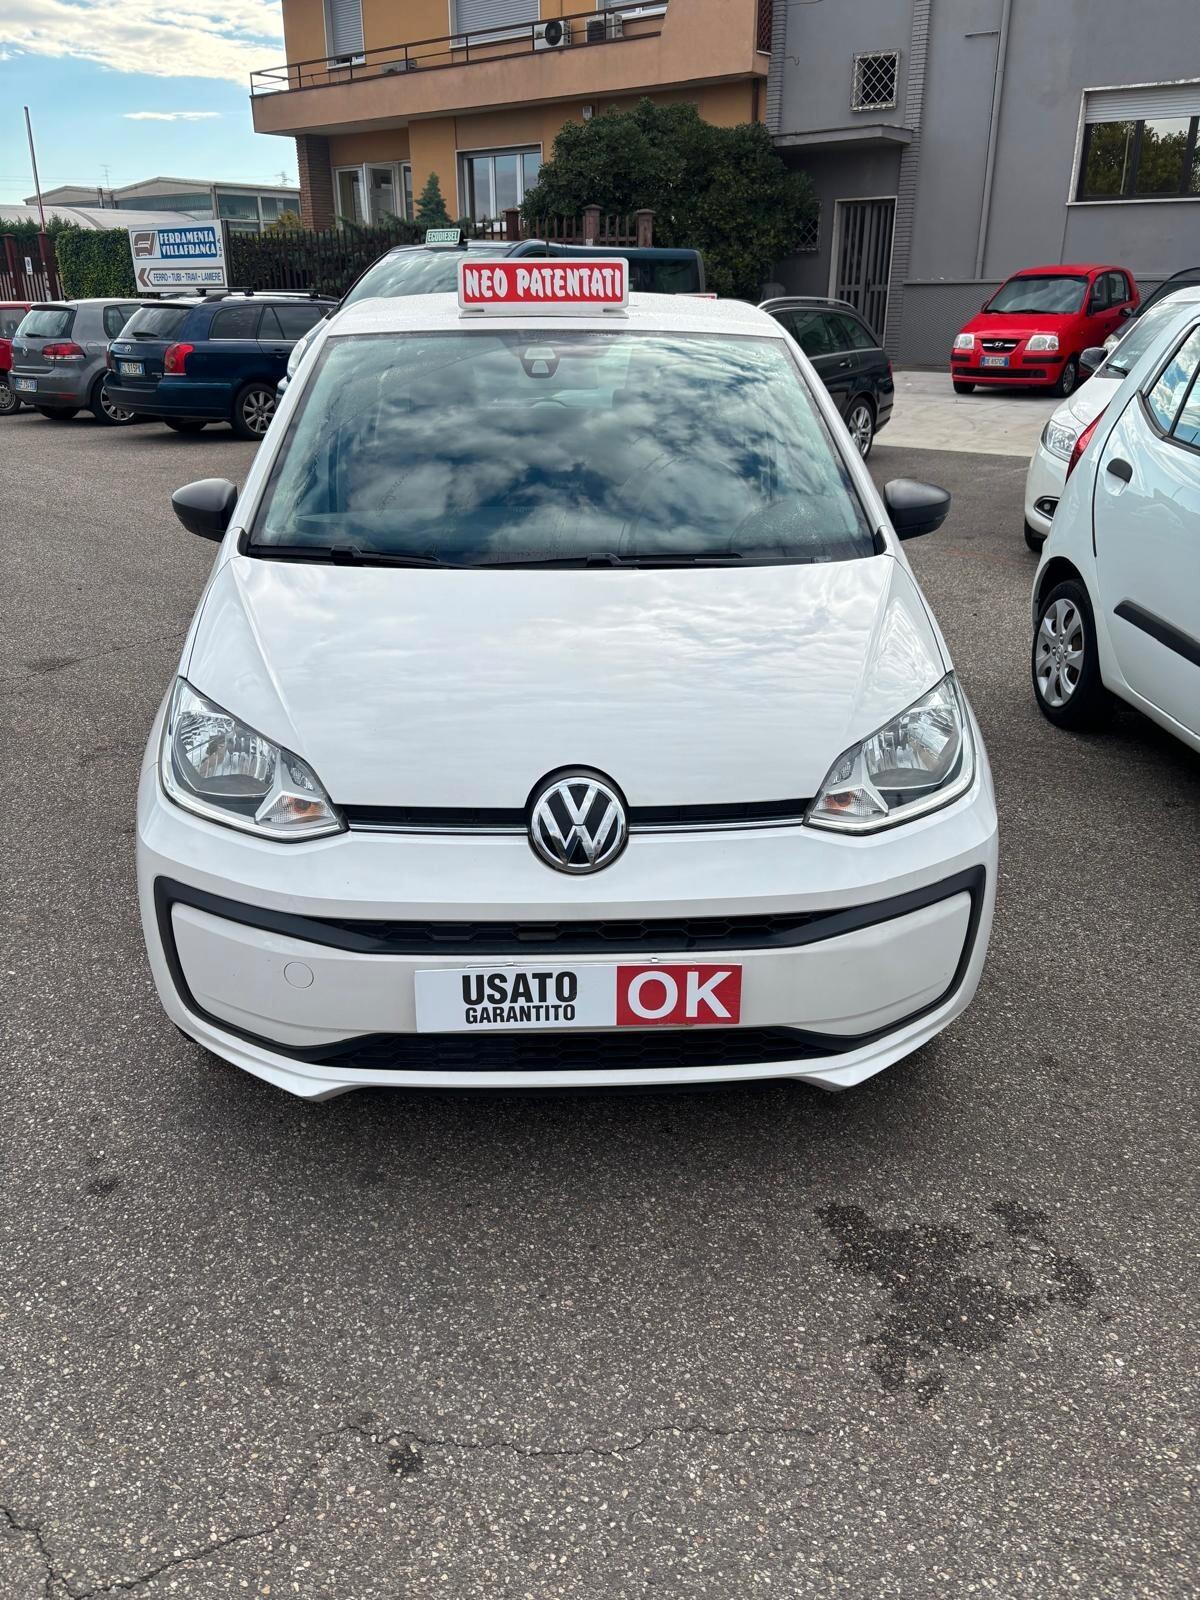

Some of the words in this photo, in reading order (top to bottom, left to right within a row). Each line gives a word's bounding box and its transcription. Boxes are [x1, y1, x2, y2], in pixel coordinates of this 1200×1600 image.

[159, 231, 215, 244] FERRAMENTA
[427, 231, 458, 241] ECODIESEL
[160, 243, 216, 256] VILLAFRANCA
[153, 273, 168, 282] FERRO
[171, 273, 182, 282] TUBI
[201, 272, 221, 281] LAMIERE
[465, 268, 508, 298] NEO
[516, 268, 621, 298] PATENTATI
[461, 971, 578, 1006] USATO
[627, 970, 732, 1020] OK
[465, 1003, 576, 1025] GARANTITO
